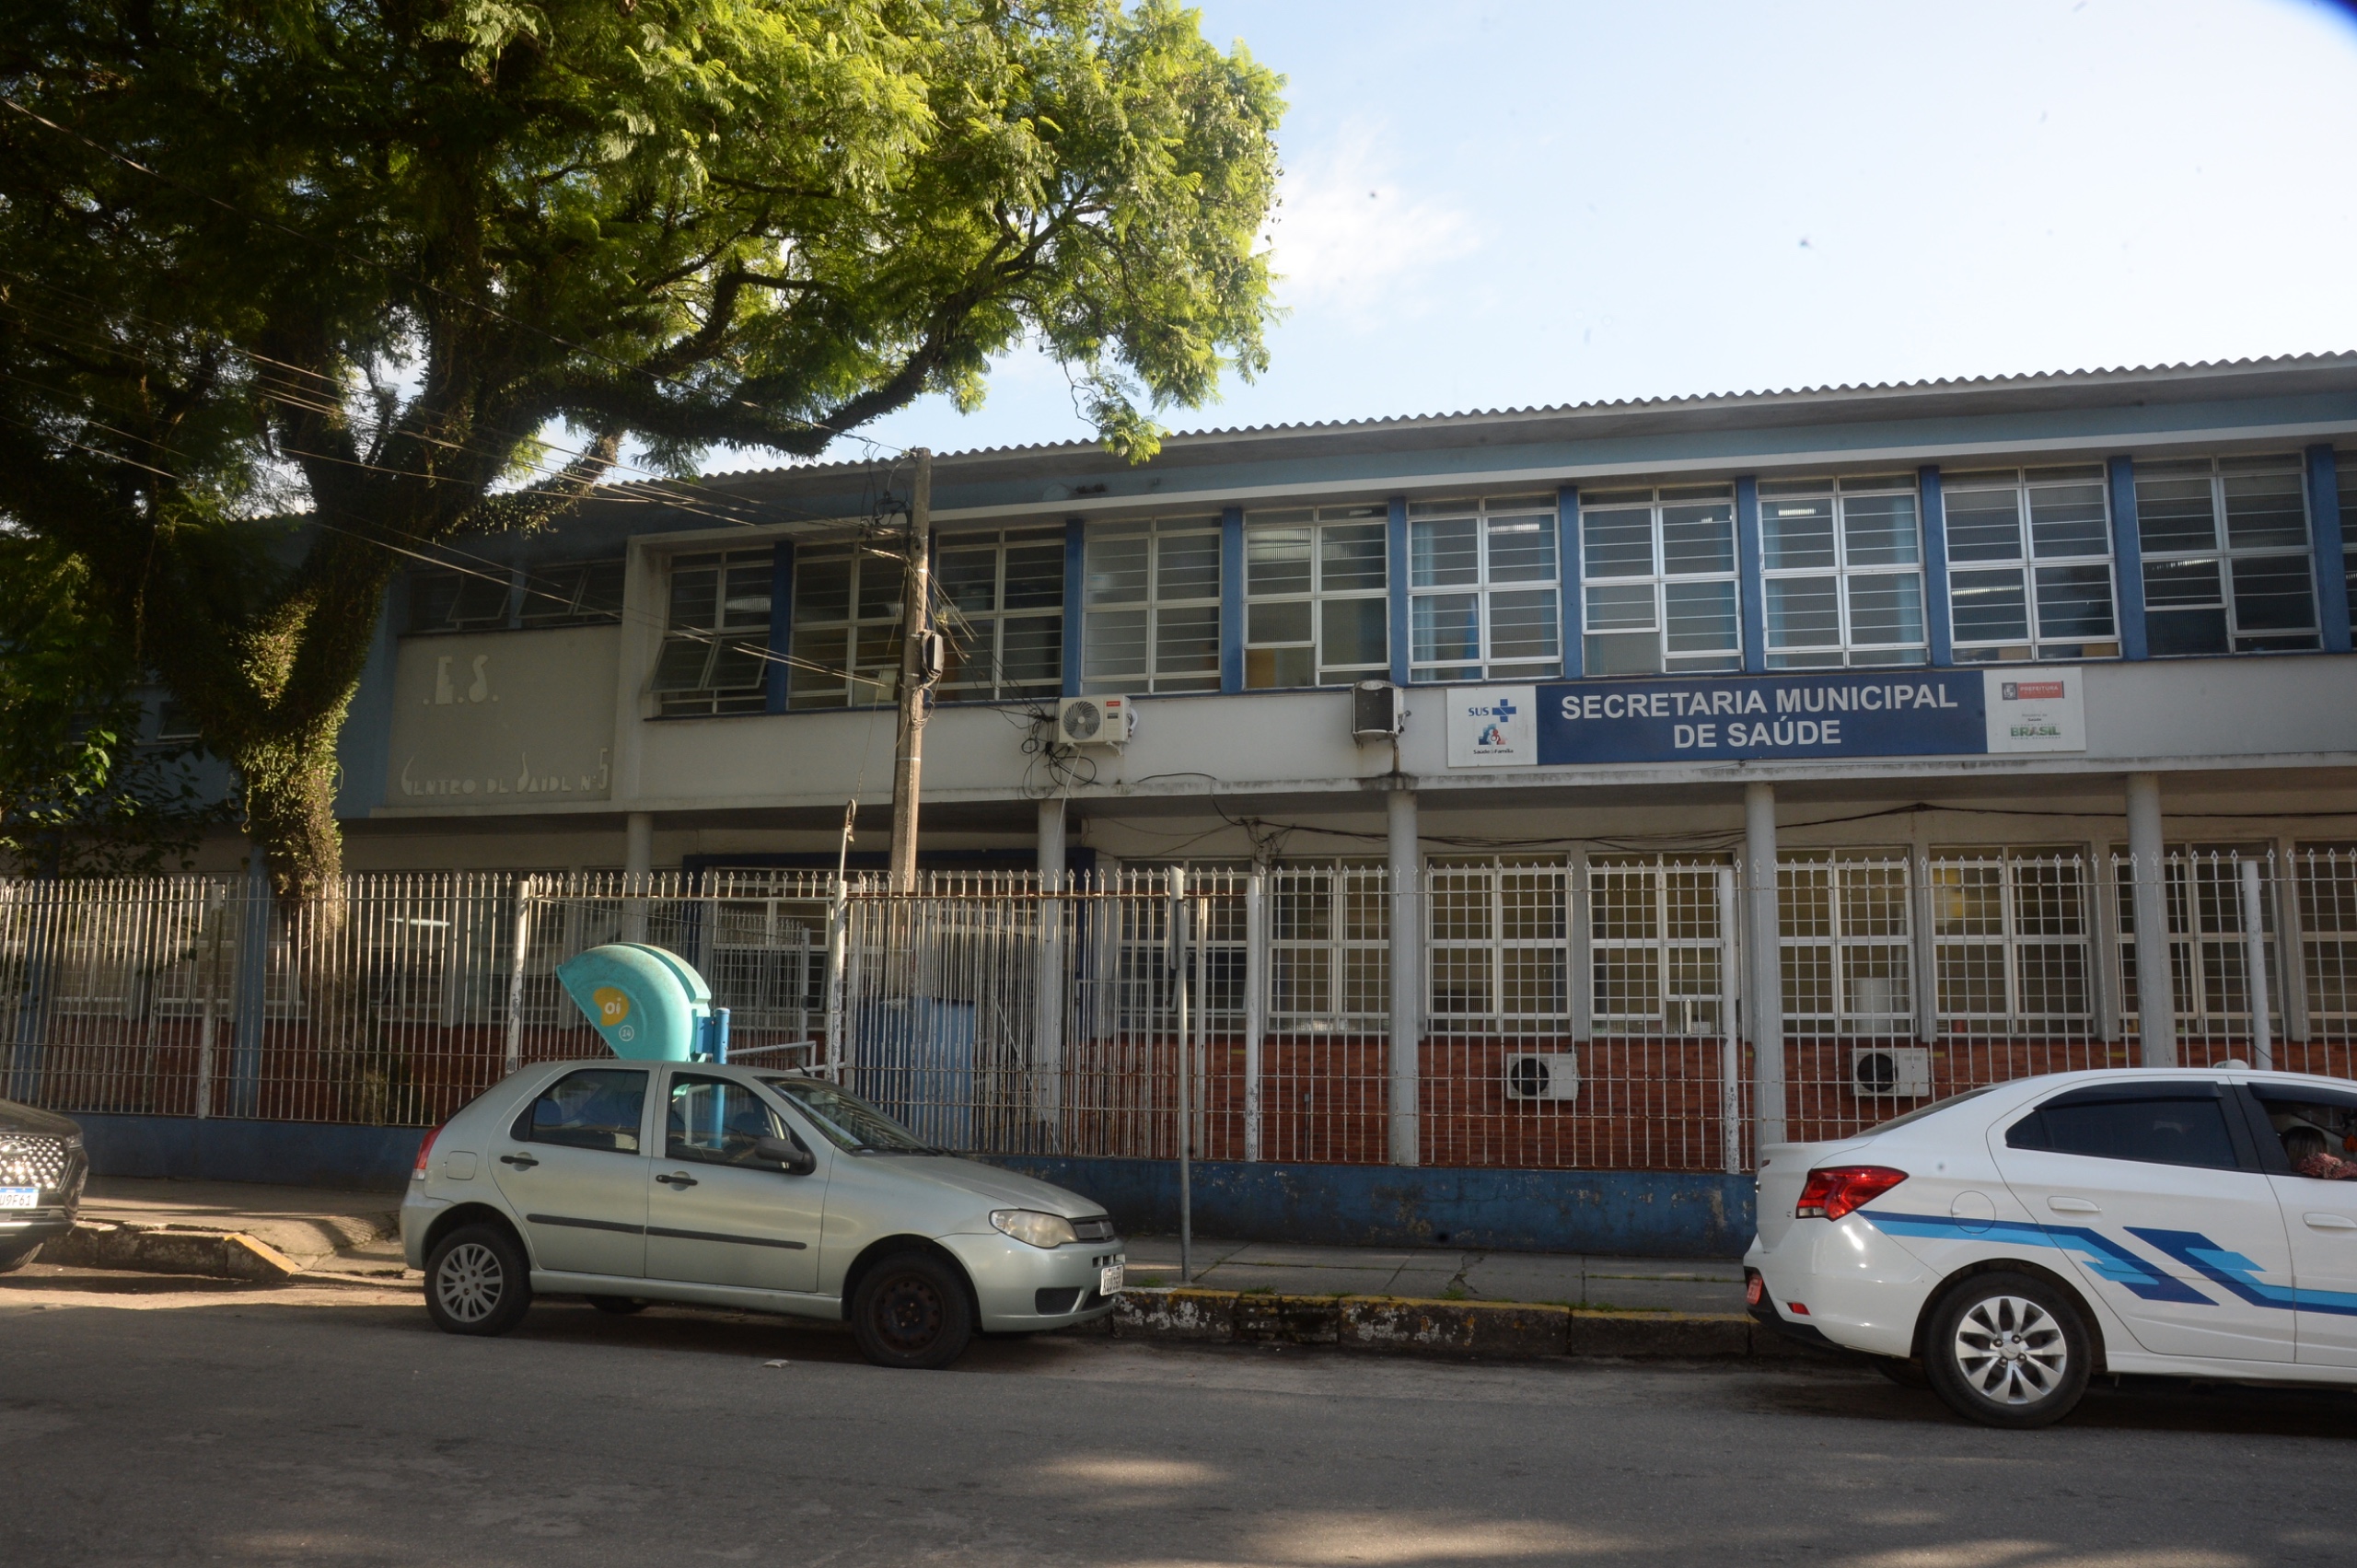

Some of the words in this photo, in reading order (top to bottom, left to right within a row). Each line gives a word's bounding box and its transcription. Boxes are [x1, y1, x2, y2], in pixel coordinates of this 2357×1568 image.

[1468, 706, 1490, 717] SUS
[1562, 690, 1768, 720] SECRETARIA
[1776, 684, 1958, 714] MUNICIPAL
[1674, 723, 1718, 749] DE
[1727, 715, 1842, 748] SAÚDE
[2010, 726, 2061, 738] BRASIL
